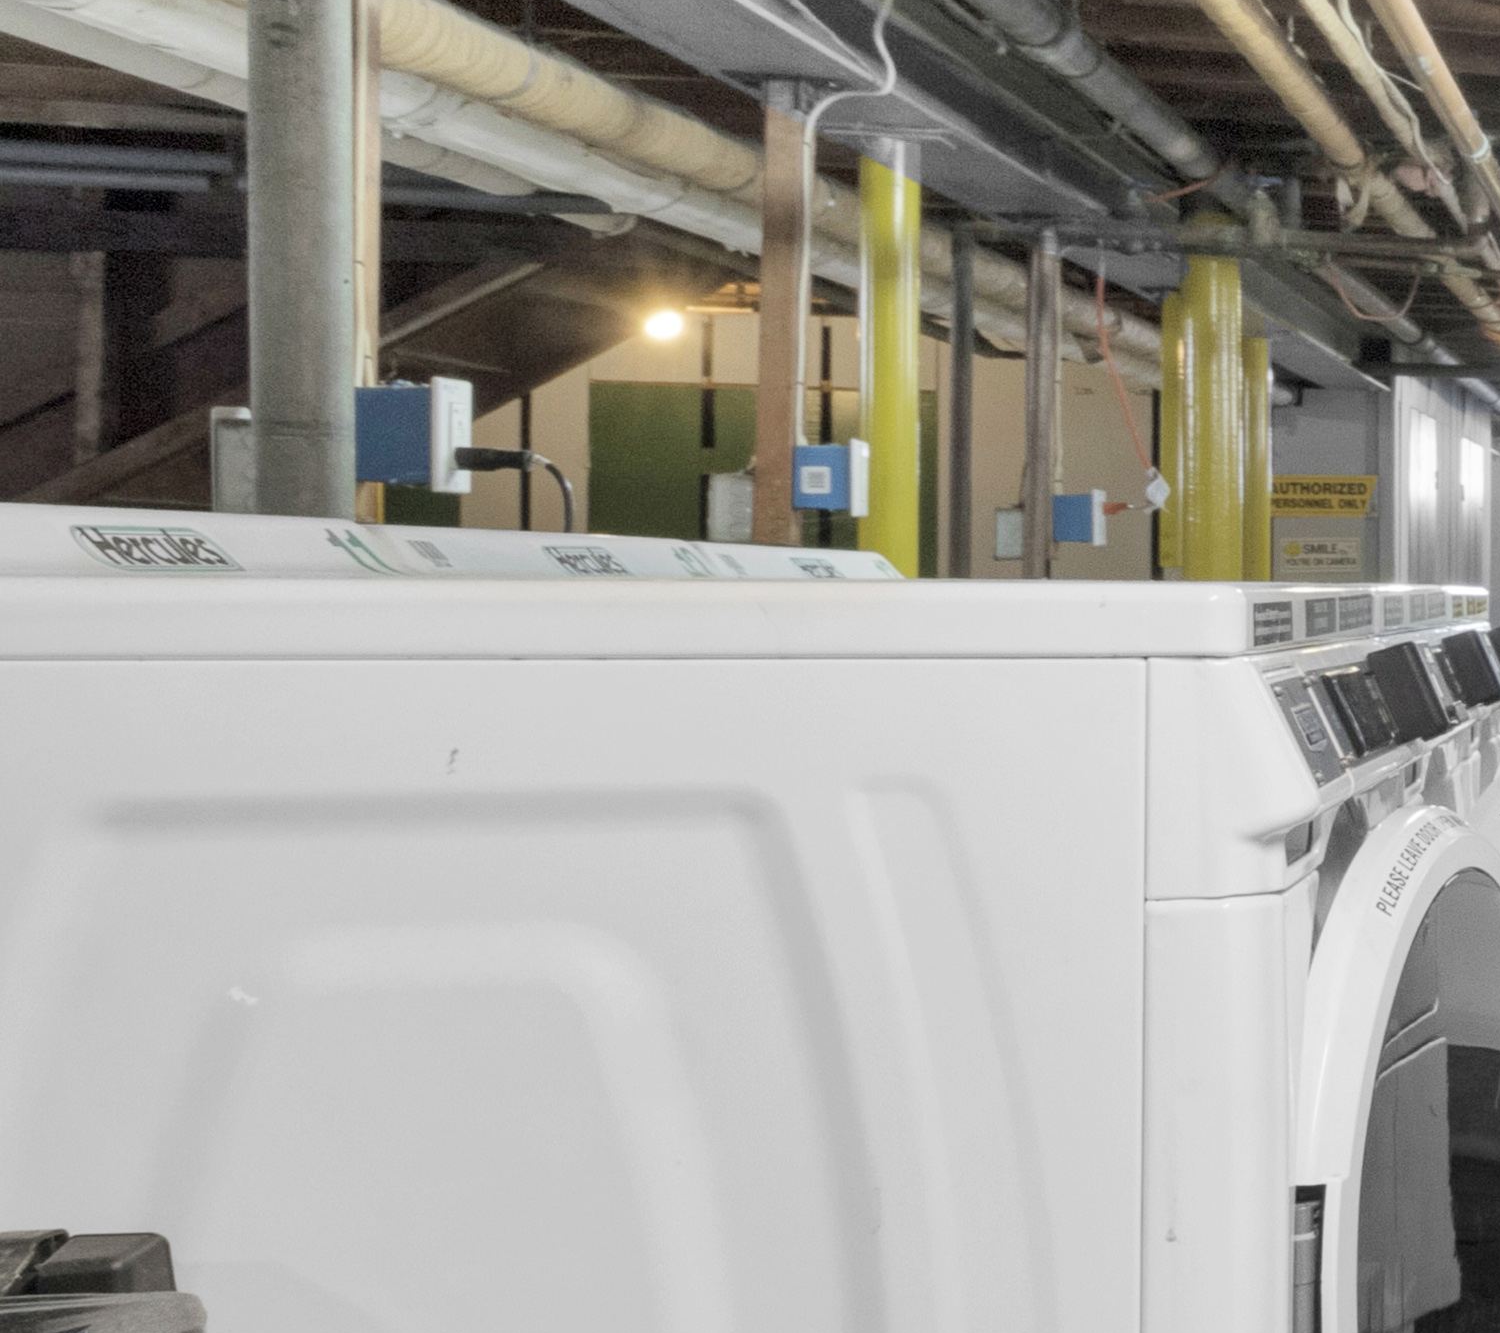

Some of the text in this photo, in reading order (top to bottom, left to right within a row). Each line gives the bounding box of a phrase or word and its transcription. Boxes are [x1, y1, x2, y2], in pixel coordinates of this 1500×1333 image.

[76, 526, 230, 566] Hercules
[1303, 544, 1337, 554] SMILE
[1376, 866, 1409, 917] PLEASE
[1397, 838, 1427, 872] LEAVE
